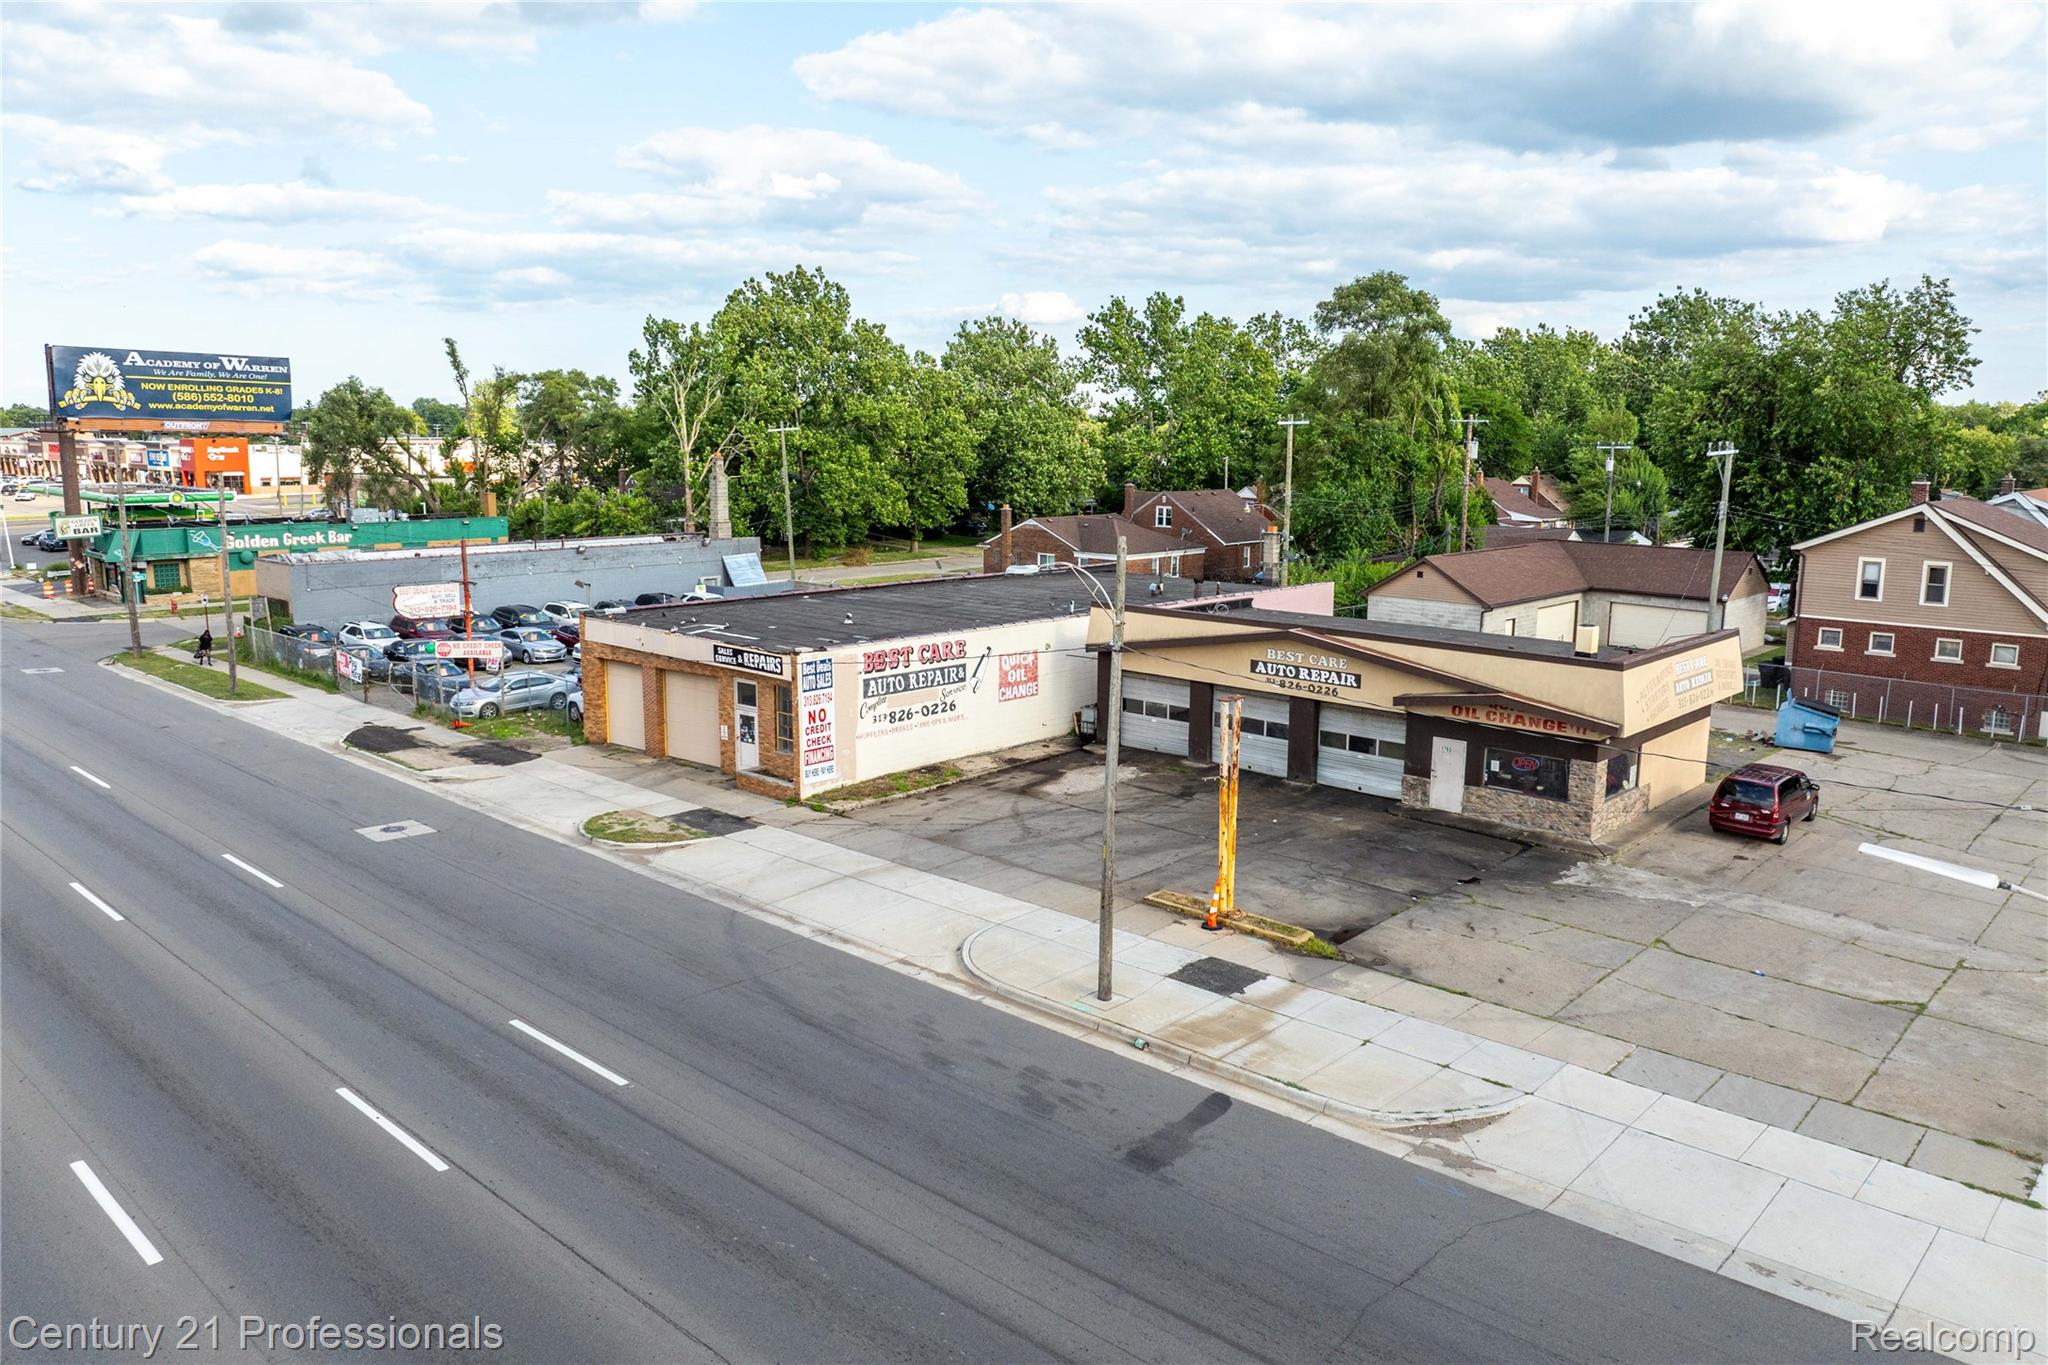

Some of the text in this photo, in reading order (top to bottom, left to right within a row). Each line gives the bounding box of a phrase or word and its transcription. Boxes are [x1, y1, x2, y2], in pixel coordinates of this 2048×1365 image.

[123, 351, 289, 374] ACADEMY OF WARREN
[153, 368, 168, 376] We
[169, 369, 184, 377] Are
[219, 371, 233, 379] We
[249, 372, 268, 380] One!
[141, 382, 166, 391] NOW
[167, 384, 224, 393] ENROLLING
[225, 386, 264, 394] GRADES
[172, 392, 254, 404] (586) 552-8010
[148, 402, 275, 413] www.academyofwarren.net
[73, 527, 99, 535] BAR
[225, 530, 353, 549] Golden Greek Bar
[717, 646, 734, 656] SALES
[862, 640, 967, 674] BEST CARE
[1266, 648, 1348, 670] BEST CARE
[715, 654, 737, 665] SERVICE
[743, 652, 782, 674] REPAIRS
[802, 672, 832, 692] AUTO SALES
[1008, 667, 1028, 683] OIL
[1255, 661, 1358, 687] AUTO REPAIR
[867, 677, 906, 697] AUTO
[999, 682, 1039, 700] CHANGE
[808, 707, 827, 725] NO
[888, 700, 957, 725] 826-0226
[1451, 705, 1480, 720] OIL
[1485, 710, 1568, 733] CHANGE
[804, 722, 832, 737] CREDIT
[806, 734, 832, 748] CHECK
[1512, 757, 1538, 770] OPEN
